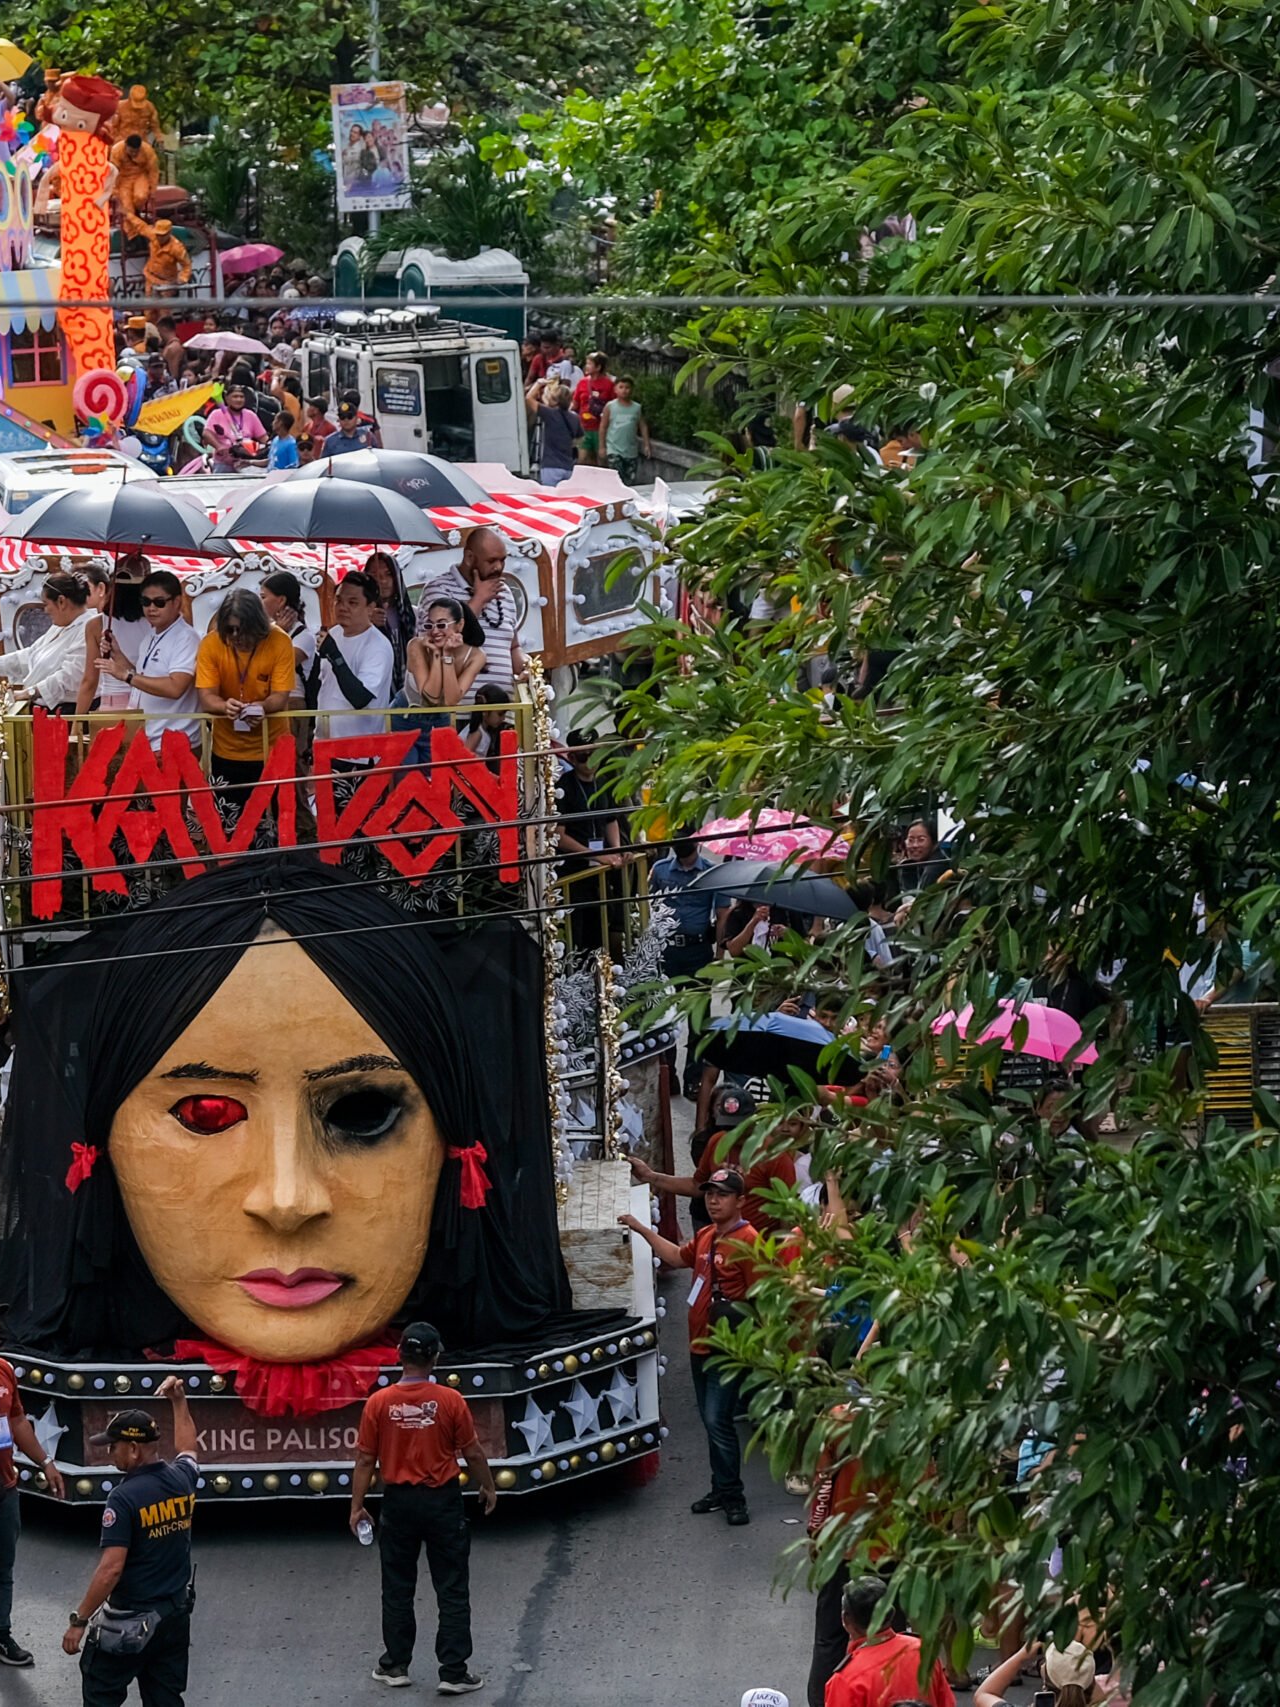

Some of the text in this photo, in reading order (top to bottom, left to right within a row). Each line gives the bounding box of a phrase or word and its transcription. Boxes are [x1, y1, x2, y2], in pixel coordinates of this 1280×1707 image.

[737, 842, 766, 853] AVON
[196, 1427, 359, 1451] KING PALISO
[149, 1519, 191, 1539] ANTI-CR
